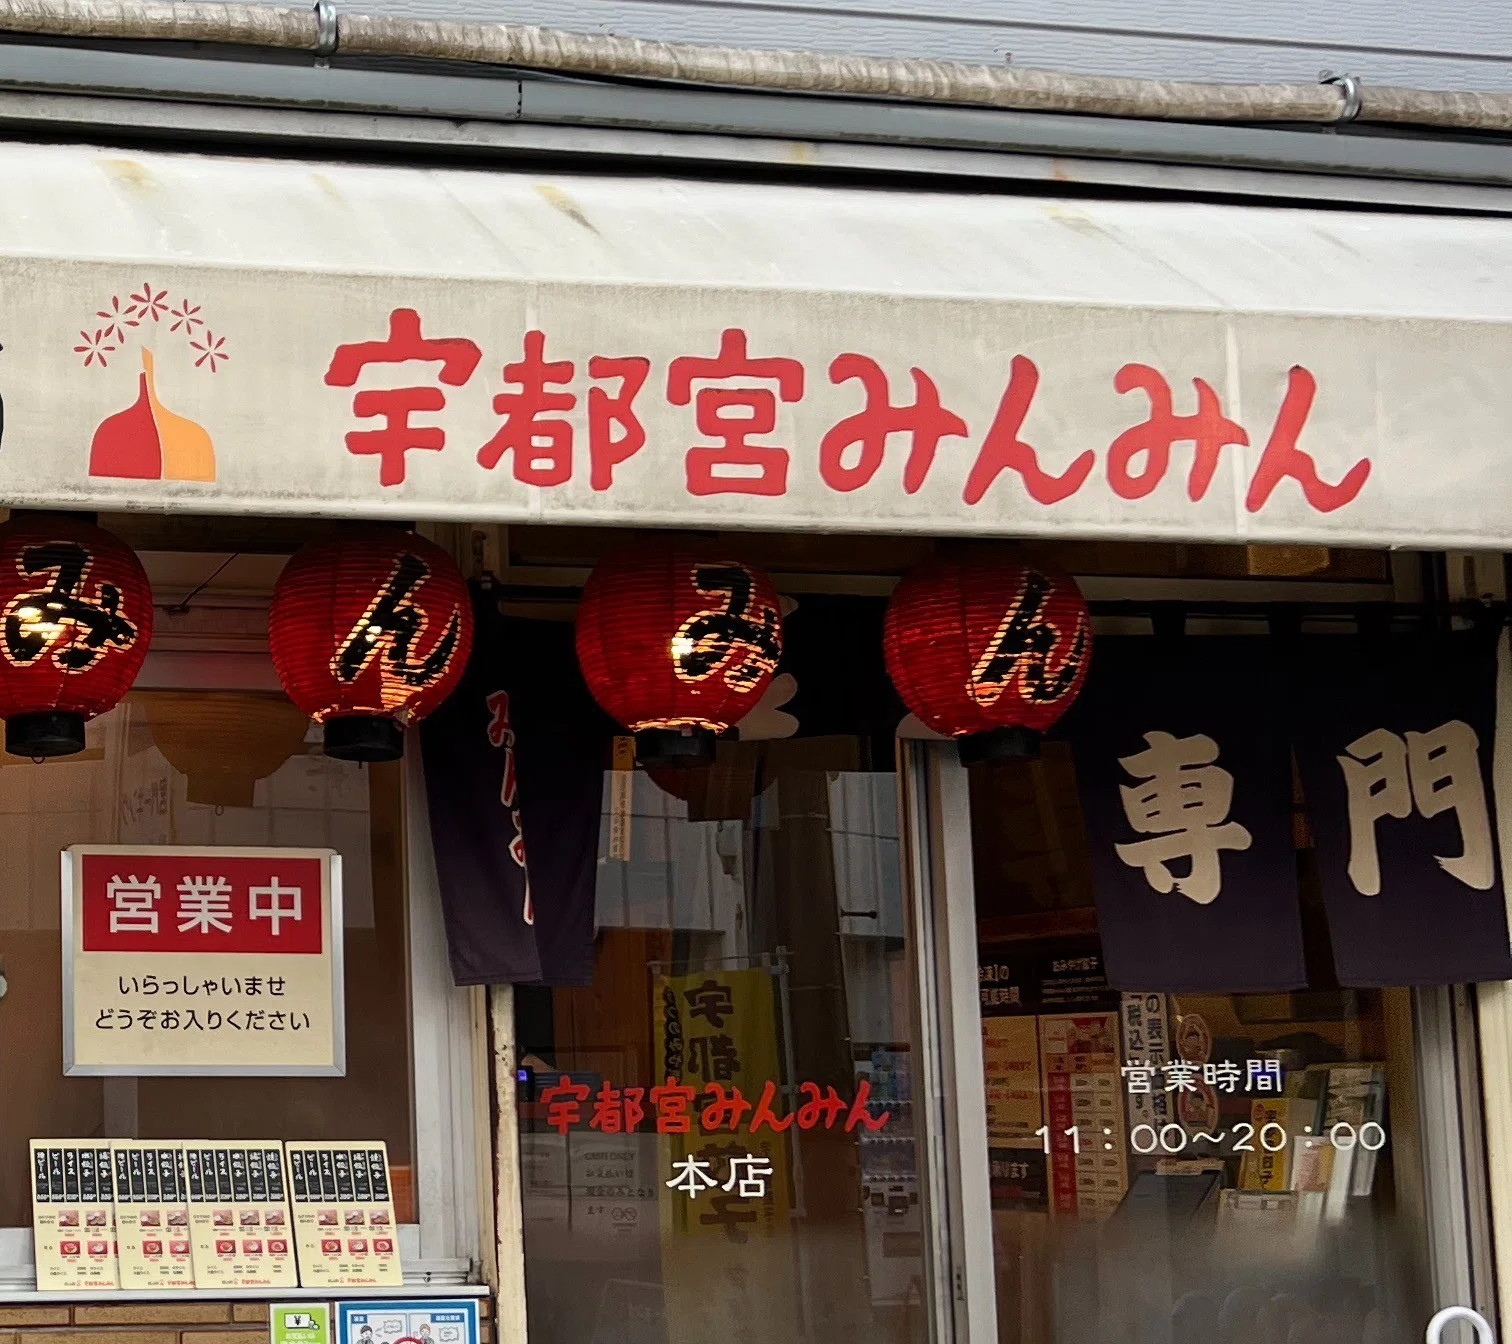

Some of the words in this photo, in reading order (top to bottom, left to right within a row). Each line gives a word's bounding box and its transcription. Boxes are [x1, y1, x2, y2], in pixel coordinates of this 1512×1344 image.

[324, 308, 1373, 514] 宇都宮みんみん
[0, 540, 139, 673] み
[329, 549, 463, 684] ん
[672, 561, 784, 696] み
[966, 568, 1093, 707] ん
[105, 874, 303, 936] 営業中
[117, 974, 287, 997] いらっしゃいませ
[94, 1009, 311, 1032] どうぞお入りください
[539, 1074, 889, 1137] 宇都宮みんみん
[1120, 1059, 1283, 1094] 営業時間
[665, 1153, 774, 1199] 本店
